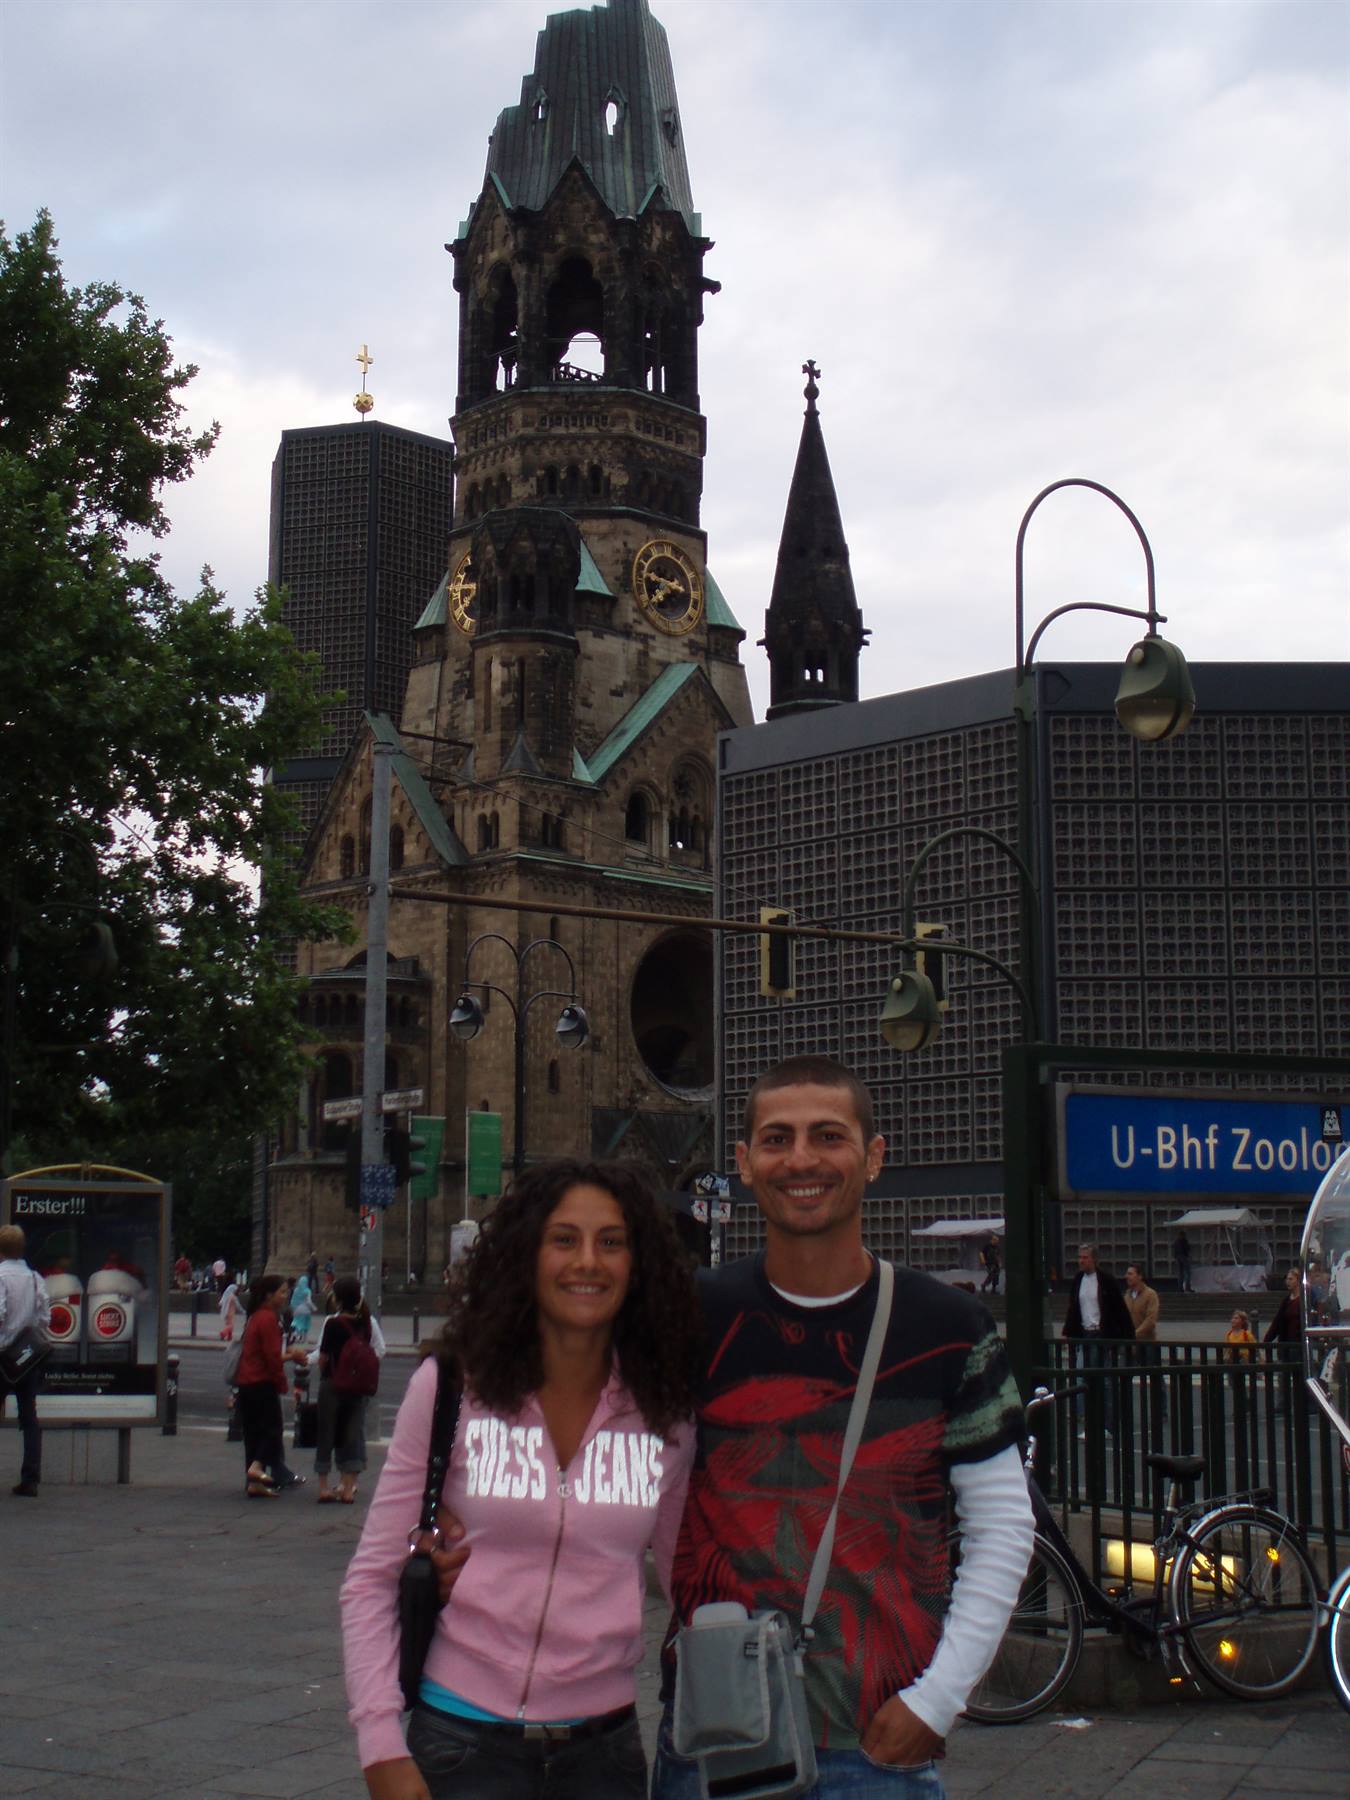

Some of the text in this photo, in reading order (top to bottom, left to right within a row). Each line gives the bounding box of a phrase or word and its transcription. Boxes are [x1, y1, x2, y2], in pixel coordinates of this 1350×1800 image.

[1111, 1124, 1218, 1169] U-Bhf
[15, 1196, 86, 1215] Erster!!!
[464, 1417, 664, 1507] GUESS JEANS
